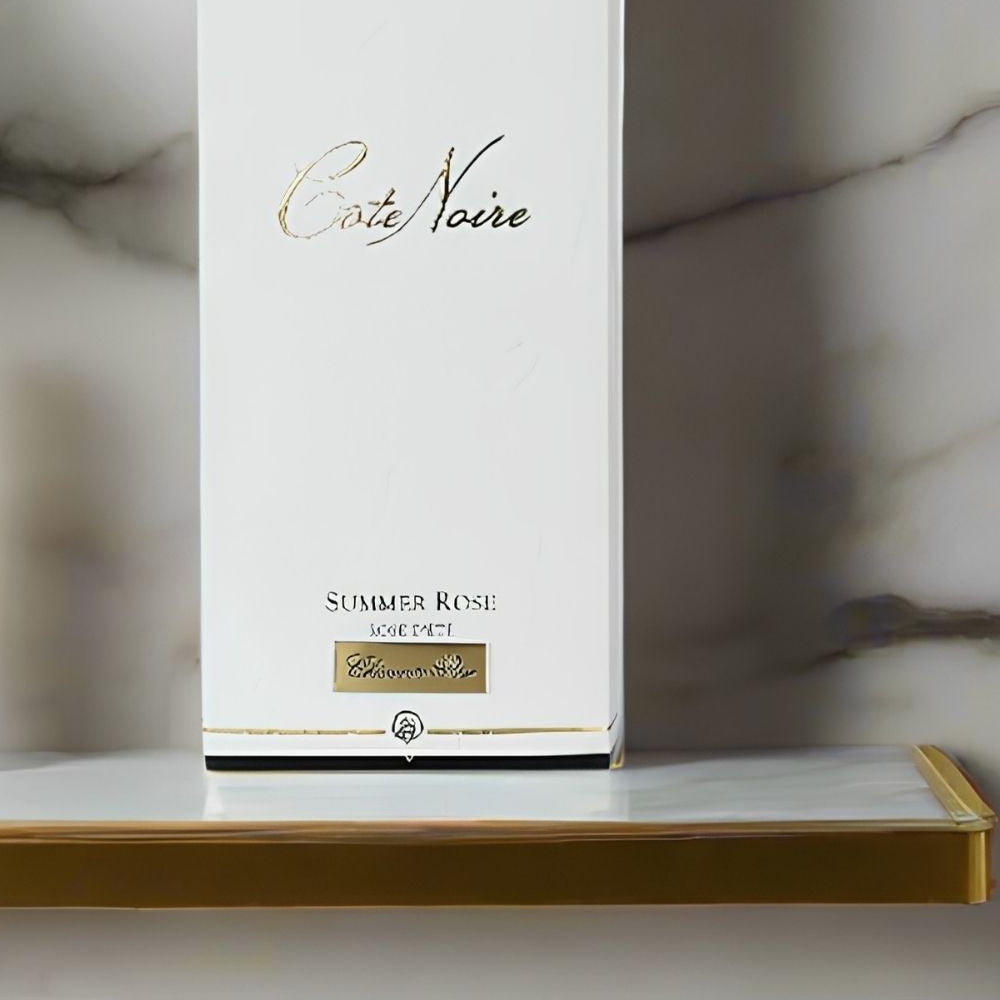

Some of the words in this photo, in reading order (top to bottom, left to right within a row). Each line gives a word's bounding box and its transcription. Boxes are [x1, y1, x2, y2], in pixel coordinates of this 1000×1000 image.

[366, 134, 532, 246] Noire
[325, 591, 425, 612] SUMMER
[436, 591, 497, 612] ROSE
